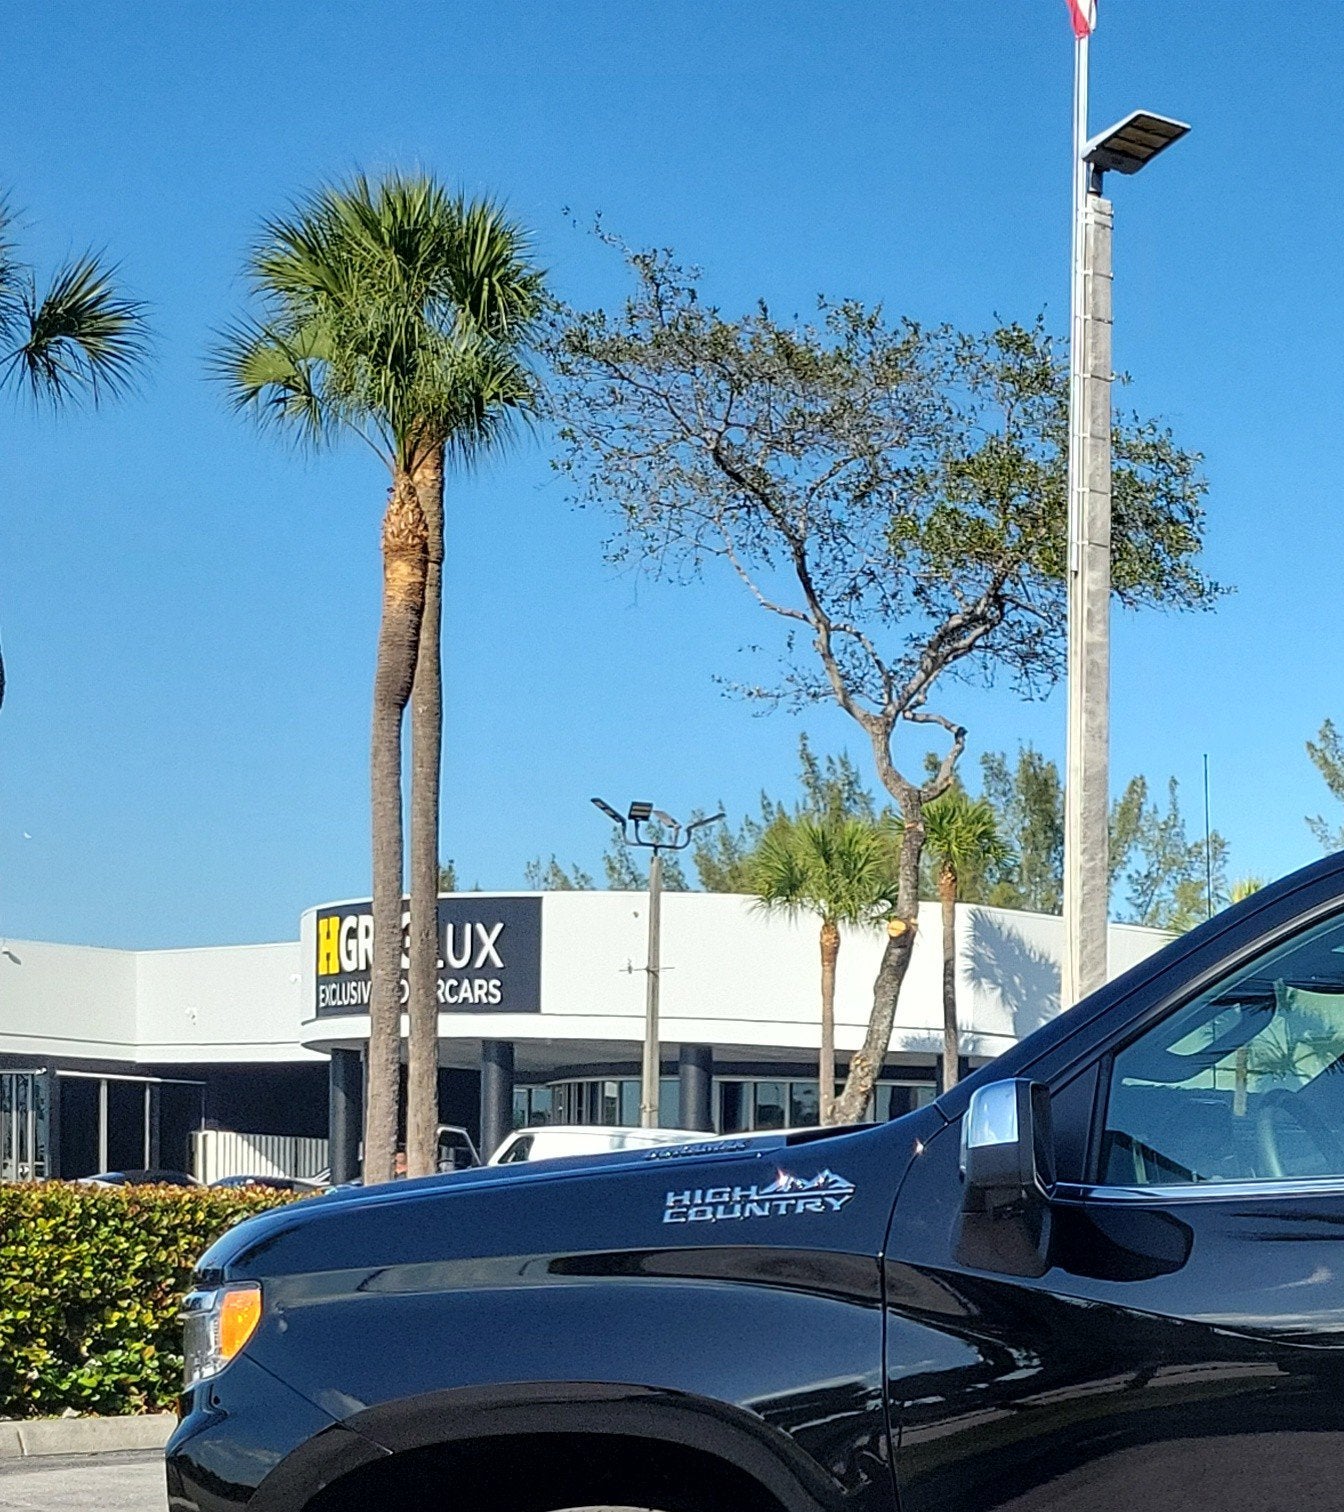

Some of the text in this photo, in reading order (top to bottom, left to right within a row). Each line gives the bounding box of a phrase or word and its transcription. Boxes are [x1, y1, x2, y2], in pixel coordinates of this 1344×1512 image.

[319, 980, 373, 1007] EXCLUSIV
[663, 1195, 853, 1223] COUNTRY
[665, 1185, 758, 1206] HIGH
